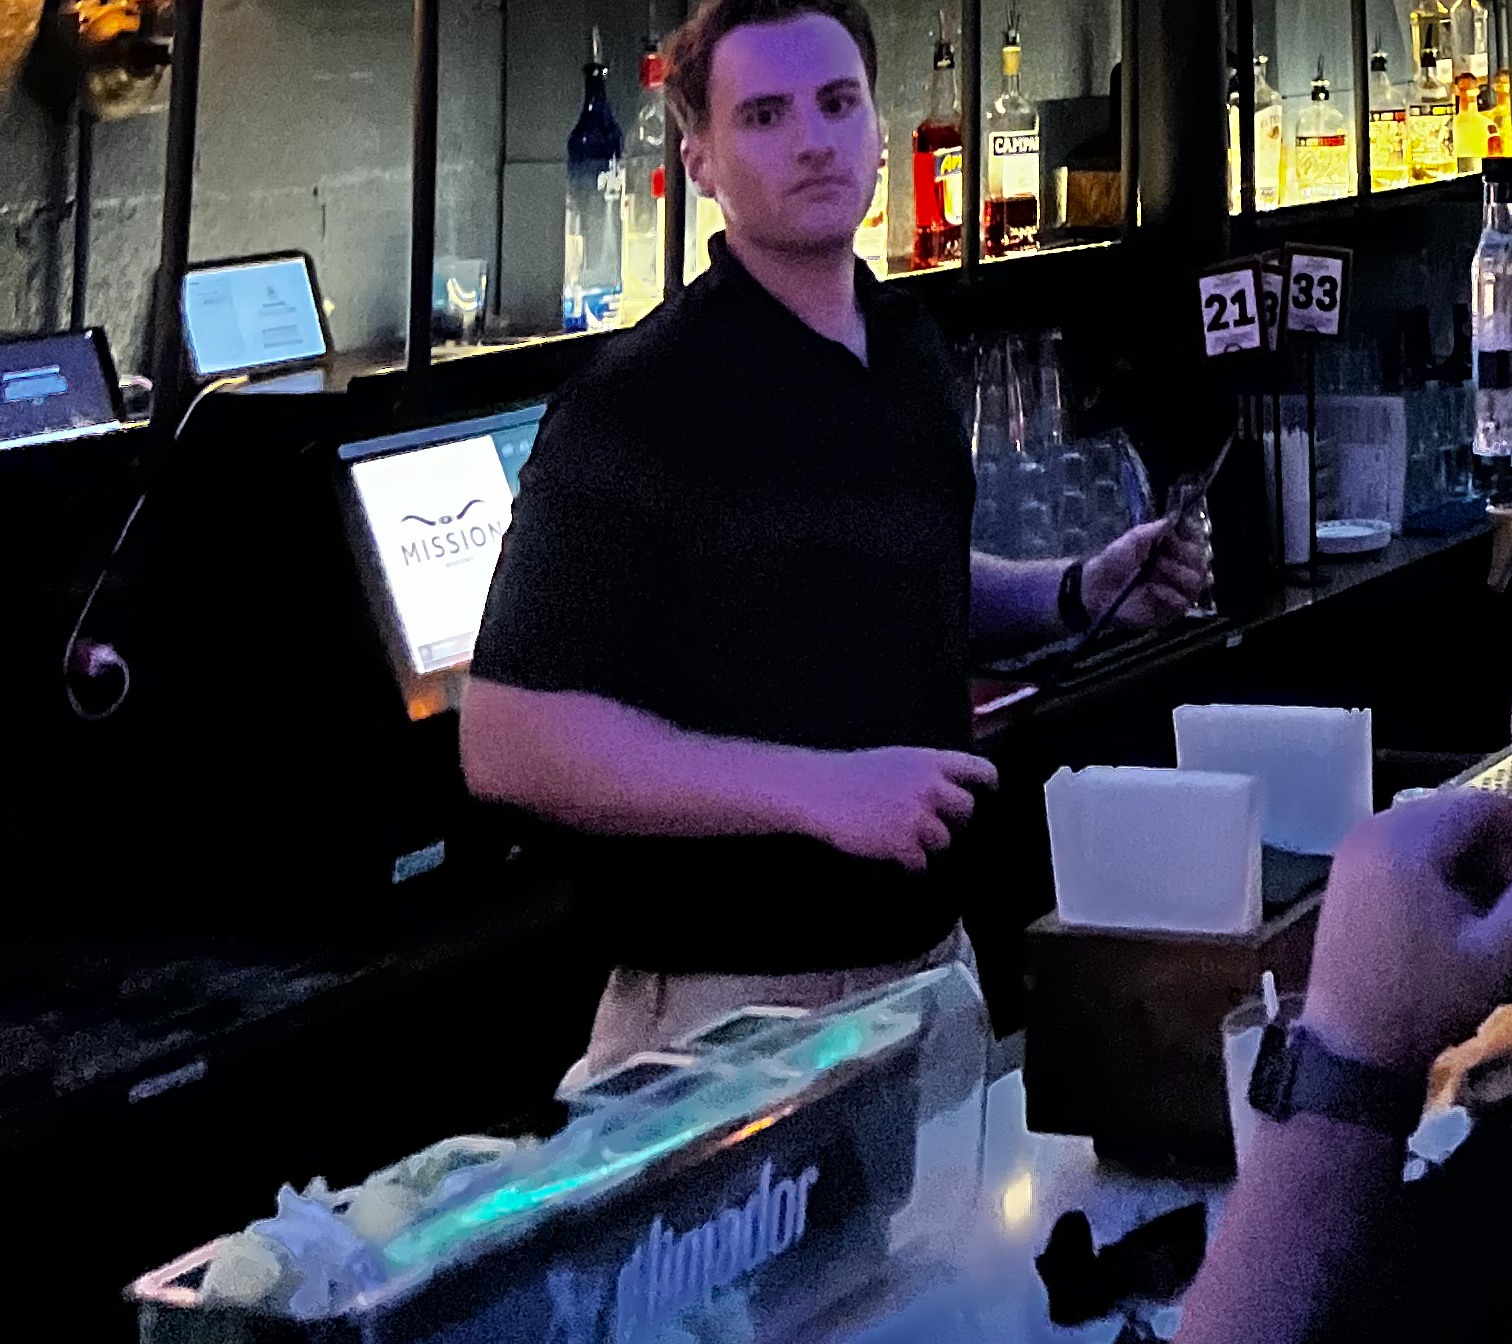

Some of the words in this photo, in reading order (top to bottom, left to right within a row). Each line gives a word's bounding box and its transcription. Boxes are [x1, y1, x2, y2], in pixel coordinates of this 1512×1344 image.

[1204, 288, 1256, 333] 21
[1292, 272, 1338, 313] 33
[401, 520, 503, 566] MISSION
